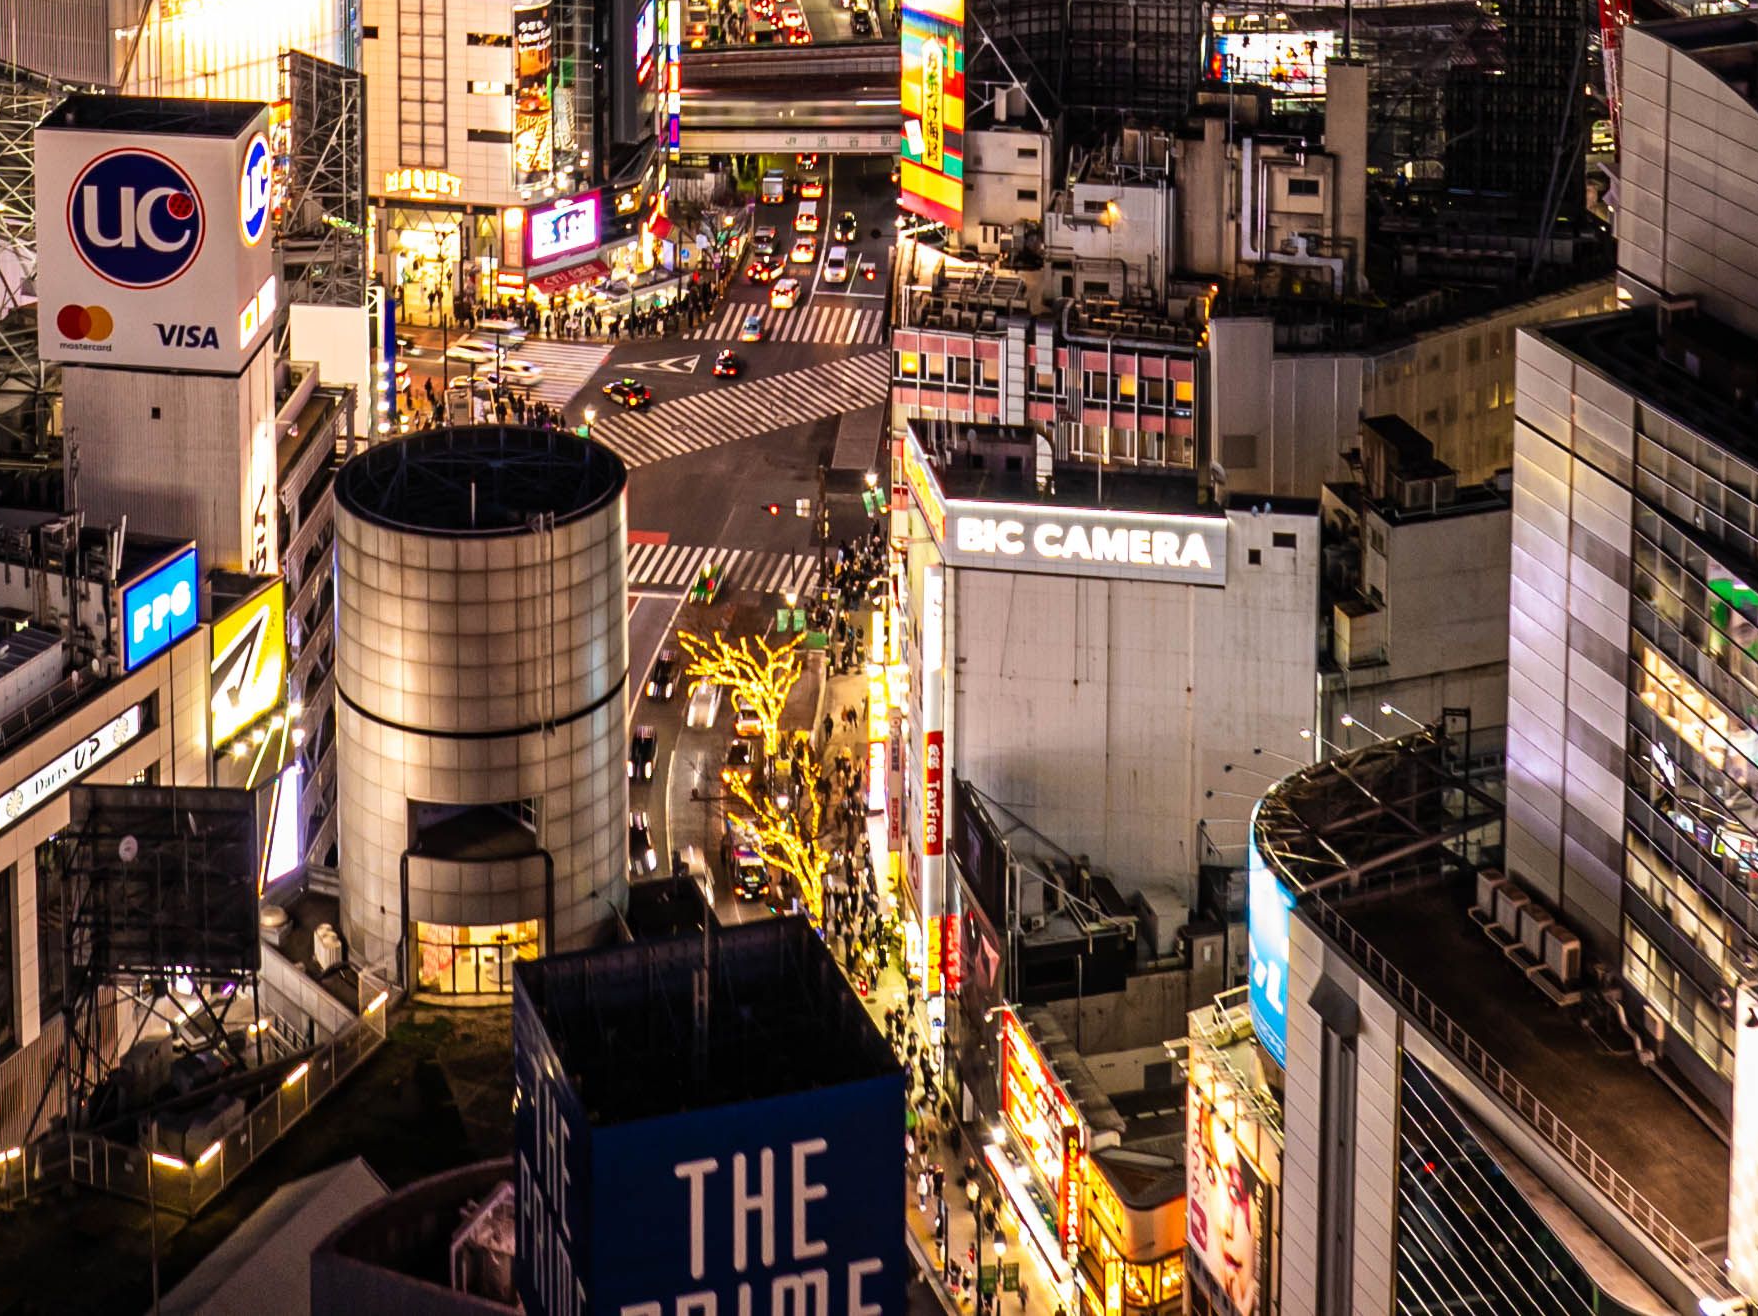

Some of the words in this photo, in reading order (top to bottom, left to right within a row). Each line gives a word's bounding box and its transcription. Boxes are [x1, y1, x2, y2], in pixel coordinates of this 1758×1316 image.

[59, 342, 112, 353] mastercard
[153, 322, 220, 349] VISA
[957, 517, 1025, 555] BIC
[1033, 523, 1212, 569] CAMERA
[34, 765, 70, 796] Darts
[74, 737, 101, 771] UP
[675, 1137, 829, 1281] THE
